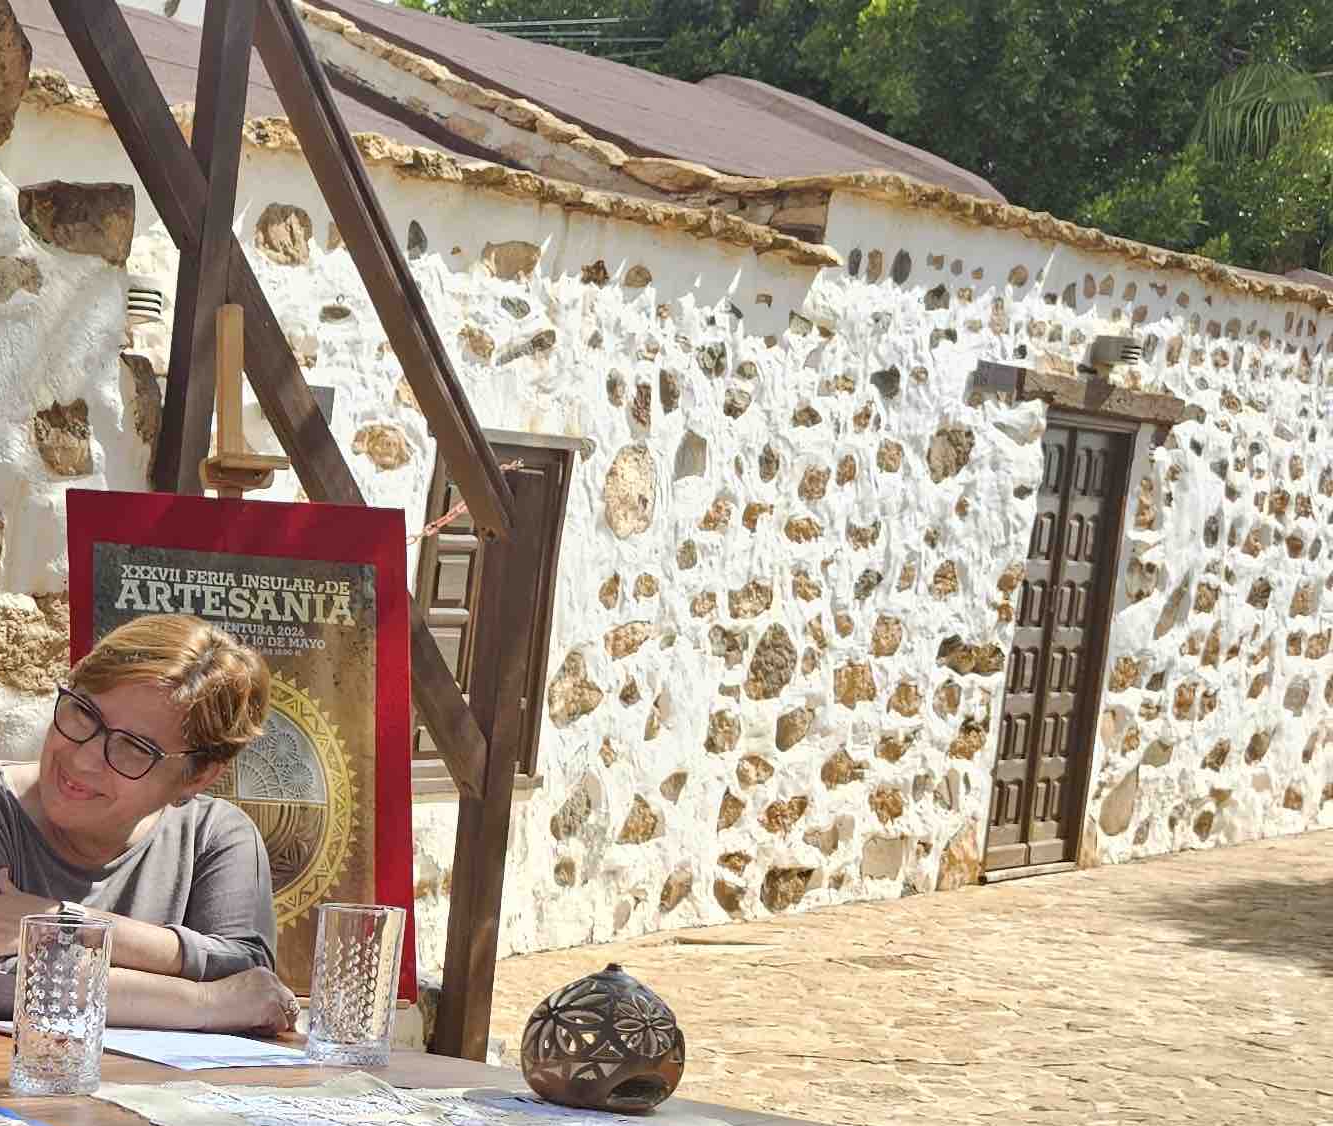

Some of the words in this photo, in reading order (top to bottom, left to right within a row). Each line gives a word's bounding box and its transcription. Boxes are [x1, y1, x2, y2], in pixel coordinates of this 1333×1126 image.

[121, 564, 182, 582] XXXVII
[185, 569, 236, 586] FERIA
[241, 574, 315, 593] INSULAR
[324, 580, 350, 595] DE
[115, 579, 355, 626] ARTESANÍA
[268, 637, 286, 648] DE
[288, 637, 326, 649] MAYO
